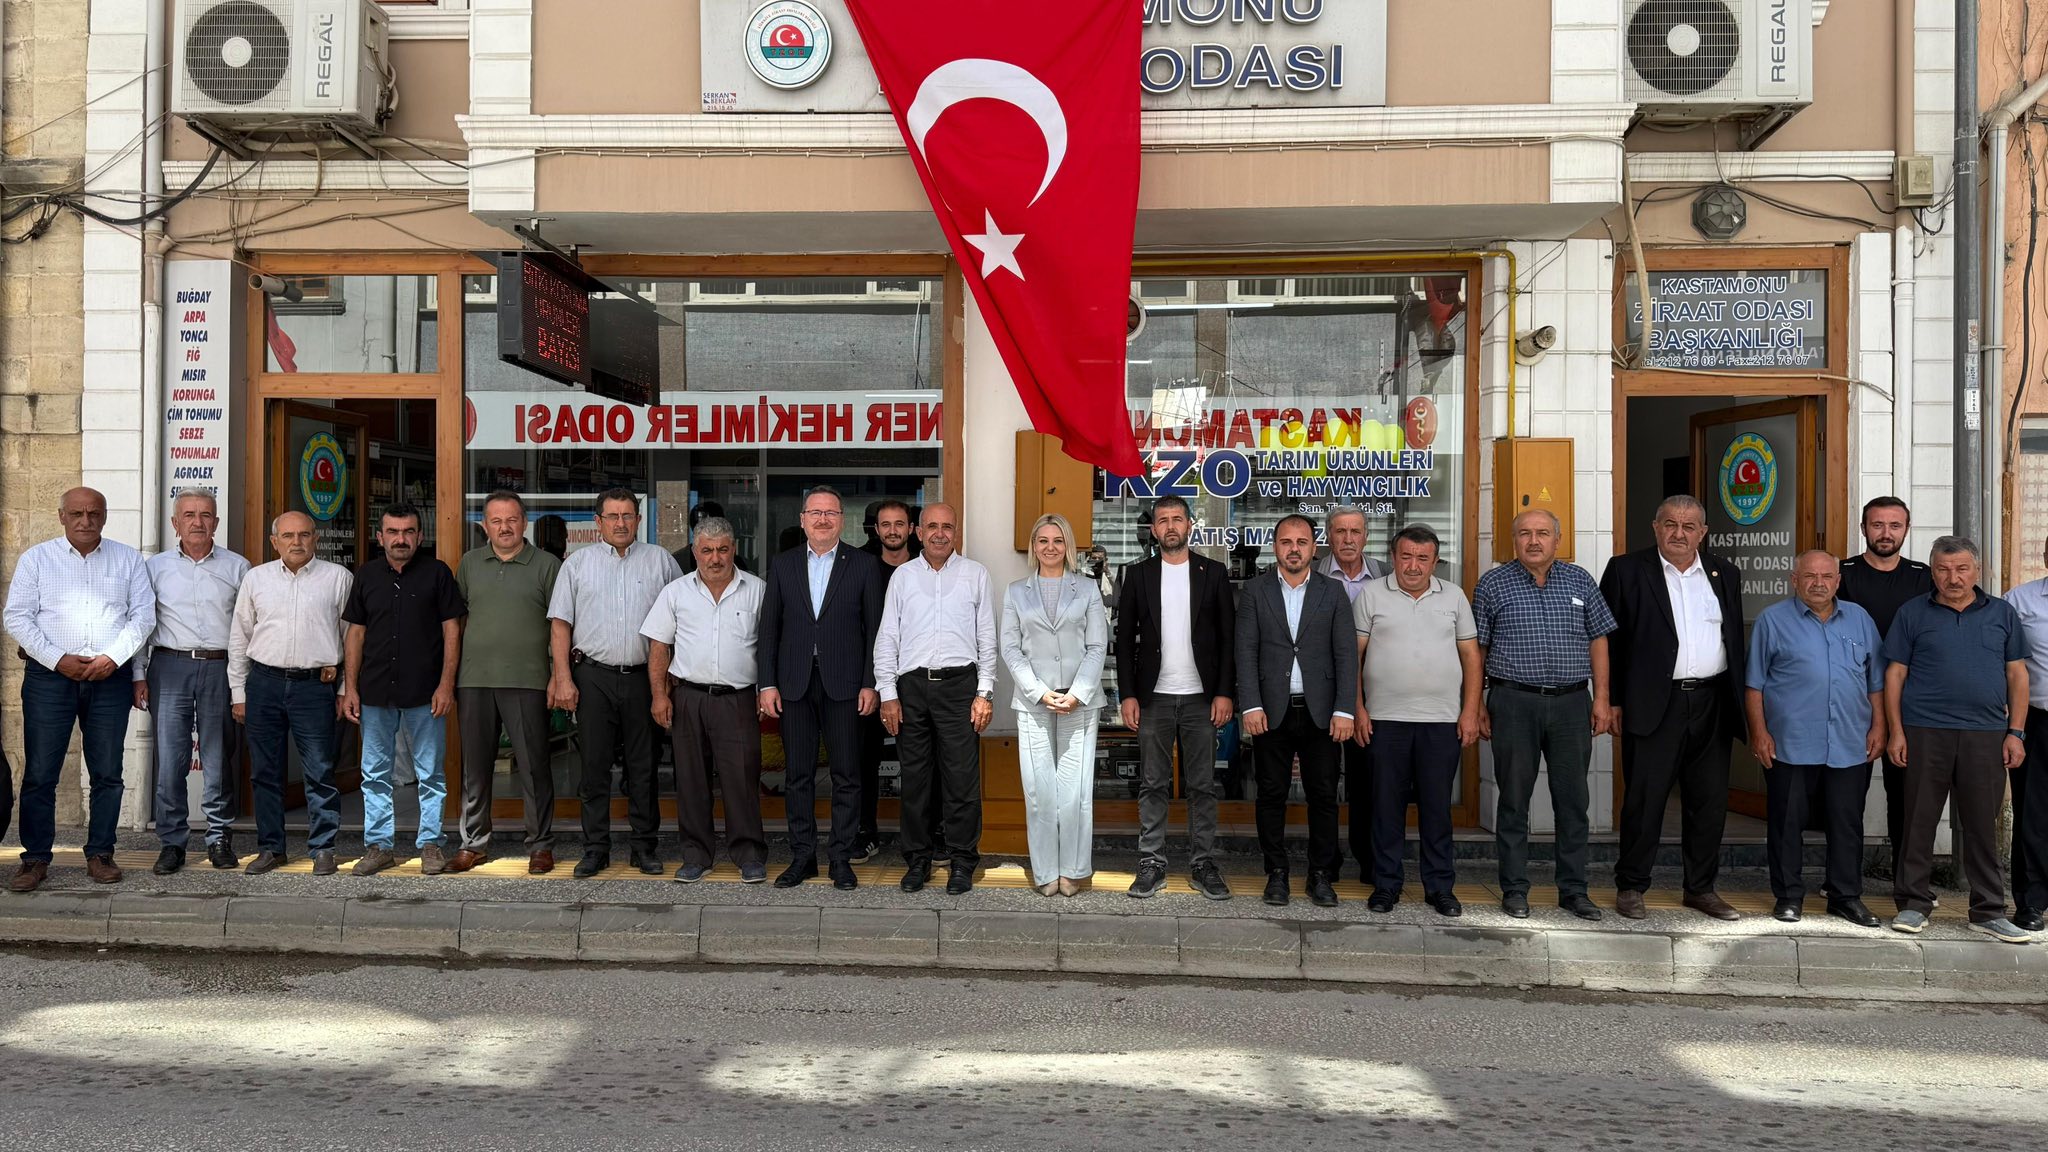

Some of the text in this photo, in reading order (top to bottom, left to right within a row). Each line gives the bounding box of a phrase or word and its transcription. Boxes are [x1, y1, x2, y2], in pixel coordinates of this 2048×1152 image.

[316, 13, 333, 98] REGAL
[1139, 42, 1345, 92] ODASI
[1660, 276, 1787, 295] KASTAMONU
[176, 288, 212, 303] BUĞDAY
[183, 311, 206, 323] ARPA
[1732, 299, 1814, 321] ODASI
[180, 330, 208, 343] YONCA
[186, 346, 201, 362] FİĞ
[1683, 355, 1698, 367] 76
[1700, 355, 1716, 367] 08
[1777, 354, 1792, 365] 76
[1794, 354, 1809, 365] 07
[182, 369, 206, 382] MISIR
[172, 388, 215, 401] KORUNGA
[167, 404, 222, 424] ÇİM TOHUMU
[179, 427, 204, 440] SEBZE
[170, 446, 220, 460] TOHUMLARI
[173, 466, 214, 479] AGROLEX
[1103, 444, 1434, 499] KZO TARIM ÜRÜNLERİ
[1257, 475, 1432, 498] ve HAYVANCILIK
[1298, 501, 1324, 513] San.
[1376, 502, 1396, 516] Şti.
[1738, 498, 1757, 506] 1997
[325, 527, 355, 538] ÜRÜNLERİ
[1188, 526, 1239, 551] ATIŞ
[1708, 531, 1790, 547] KASTAMONU
[1753, 555, 1794, 571] ODASI
